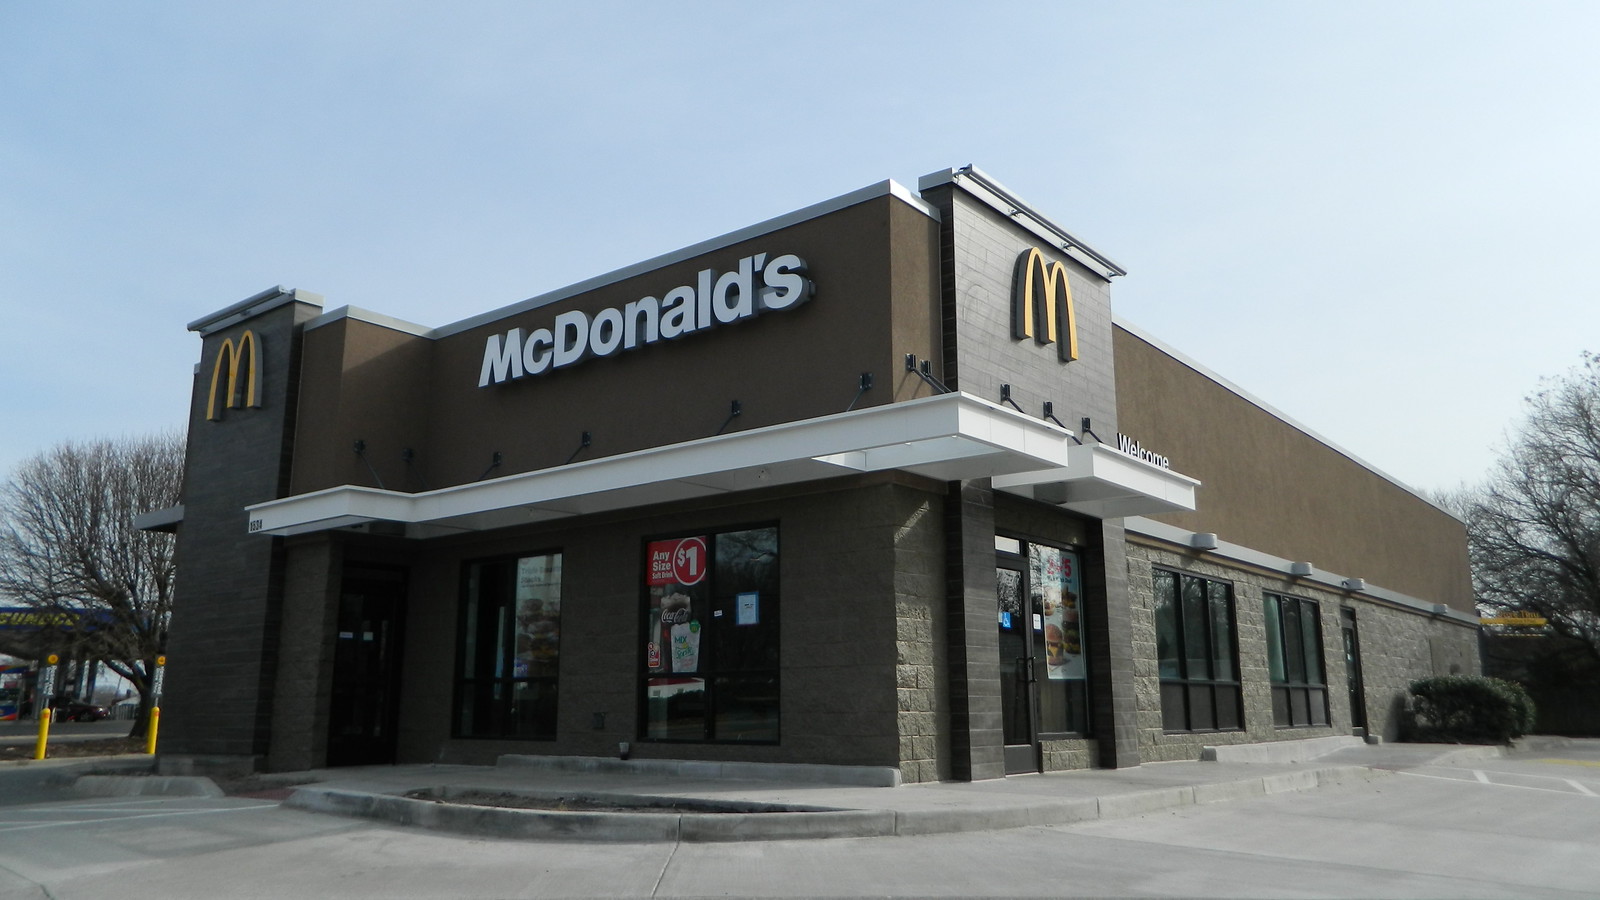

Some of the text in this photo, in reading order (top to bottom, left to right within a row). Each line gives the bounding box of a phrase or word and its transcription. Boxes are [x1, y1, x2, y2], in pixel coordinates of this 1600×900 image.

[478, 252, 806, 388] McDonald's
[1117, 432, 1170, 470] Welcome
[652, 550, 670, 562] Any
[652, 560, 671, 571] Size
